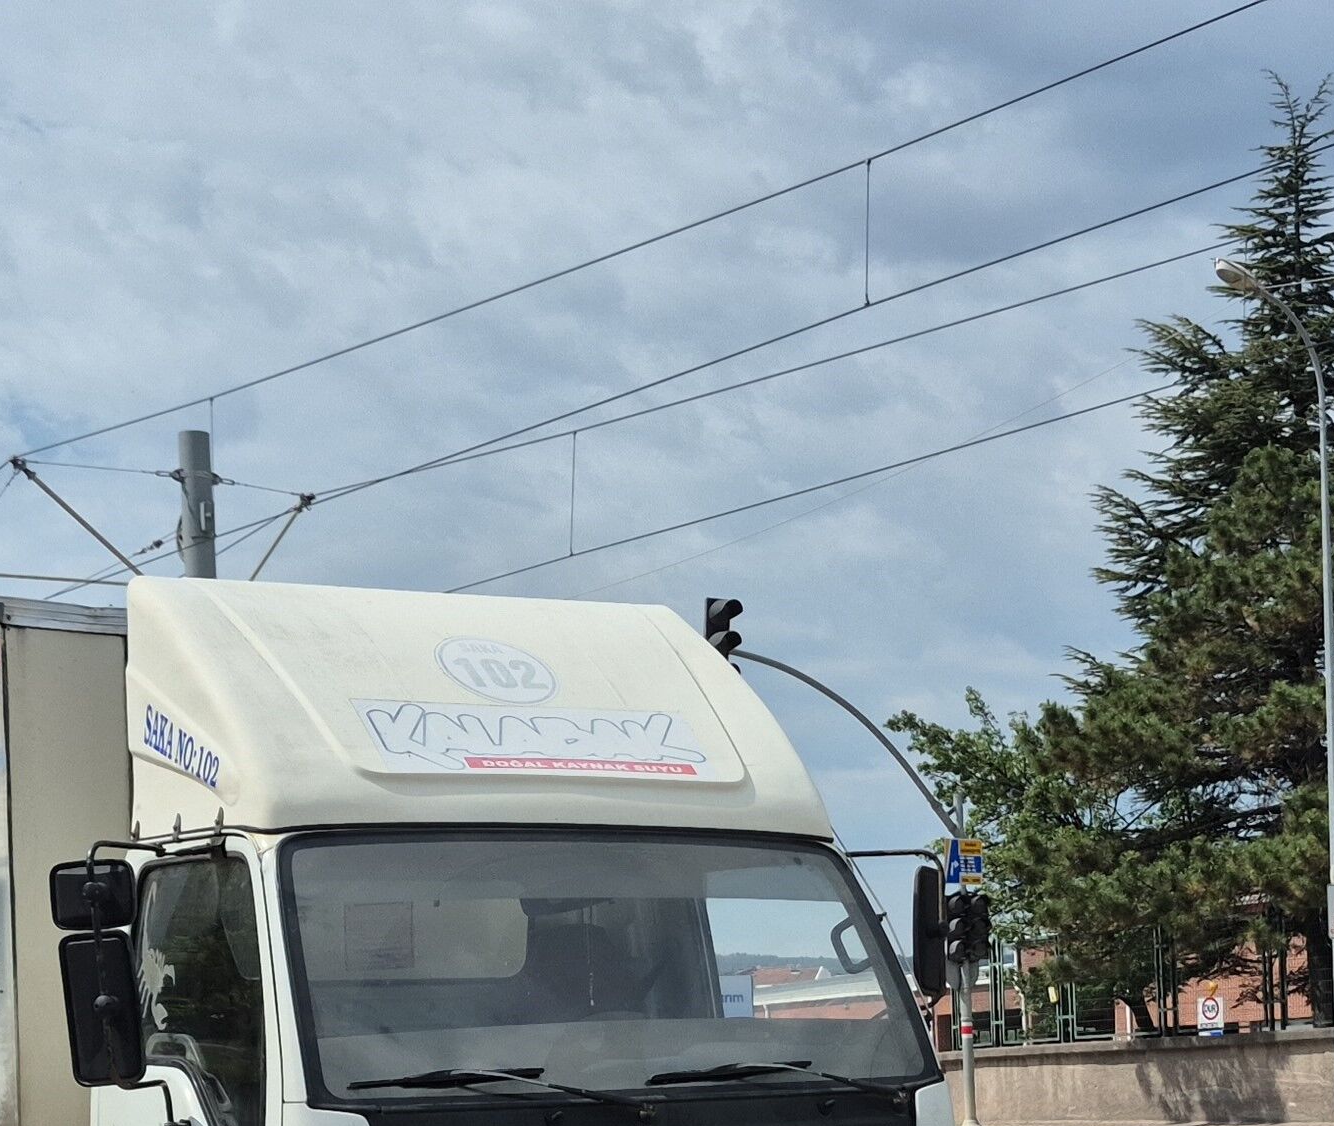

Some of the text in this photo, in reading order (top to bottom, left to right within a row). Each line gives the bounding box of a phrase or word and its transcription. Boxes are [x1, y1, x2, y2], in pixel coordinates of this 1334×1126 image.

[453, 657, 550, 689] 102
[144, 704, 220, 788] SAKA NO:102
[481, 759, 683, 774] DOĞAL KAYNAK SUYU
